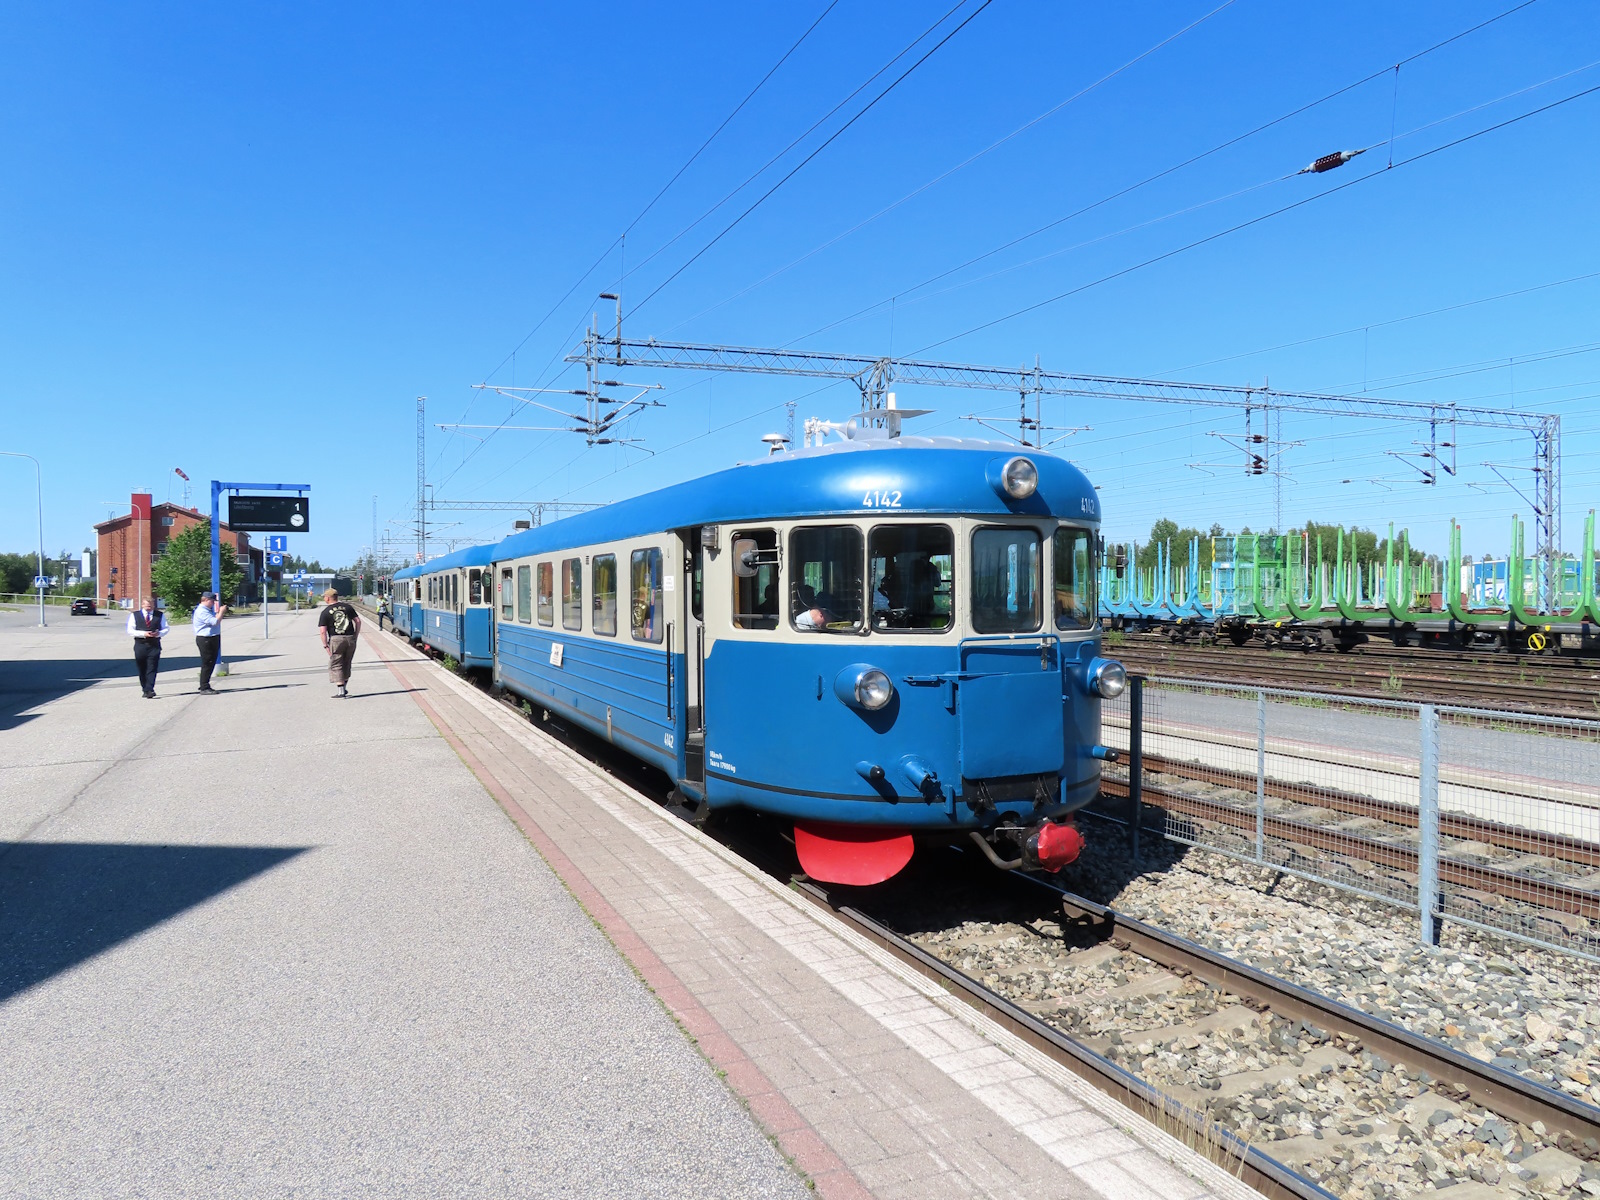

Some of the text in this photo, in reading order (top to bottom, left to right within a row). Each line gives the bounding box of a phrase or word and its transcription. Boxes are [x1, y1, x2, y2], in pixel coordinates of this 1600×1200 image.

[863, 490, 902, 507] 4142
[1081, 497, 1095, 514] 4142
[294, 502, 300, 511] 1
[275, 537, 281, 549] 1
[272, 555, 280, 564] C
[664, 732, 674, 749] 4142
